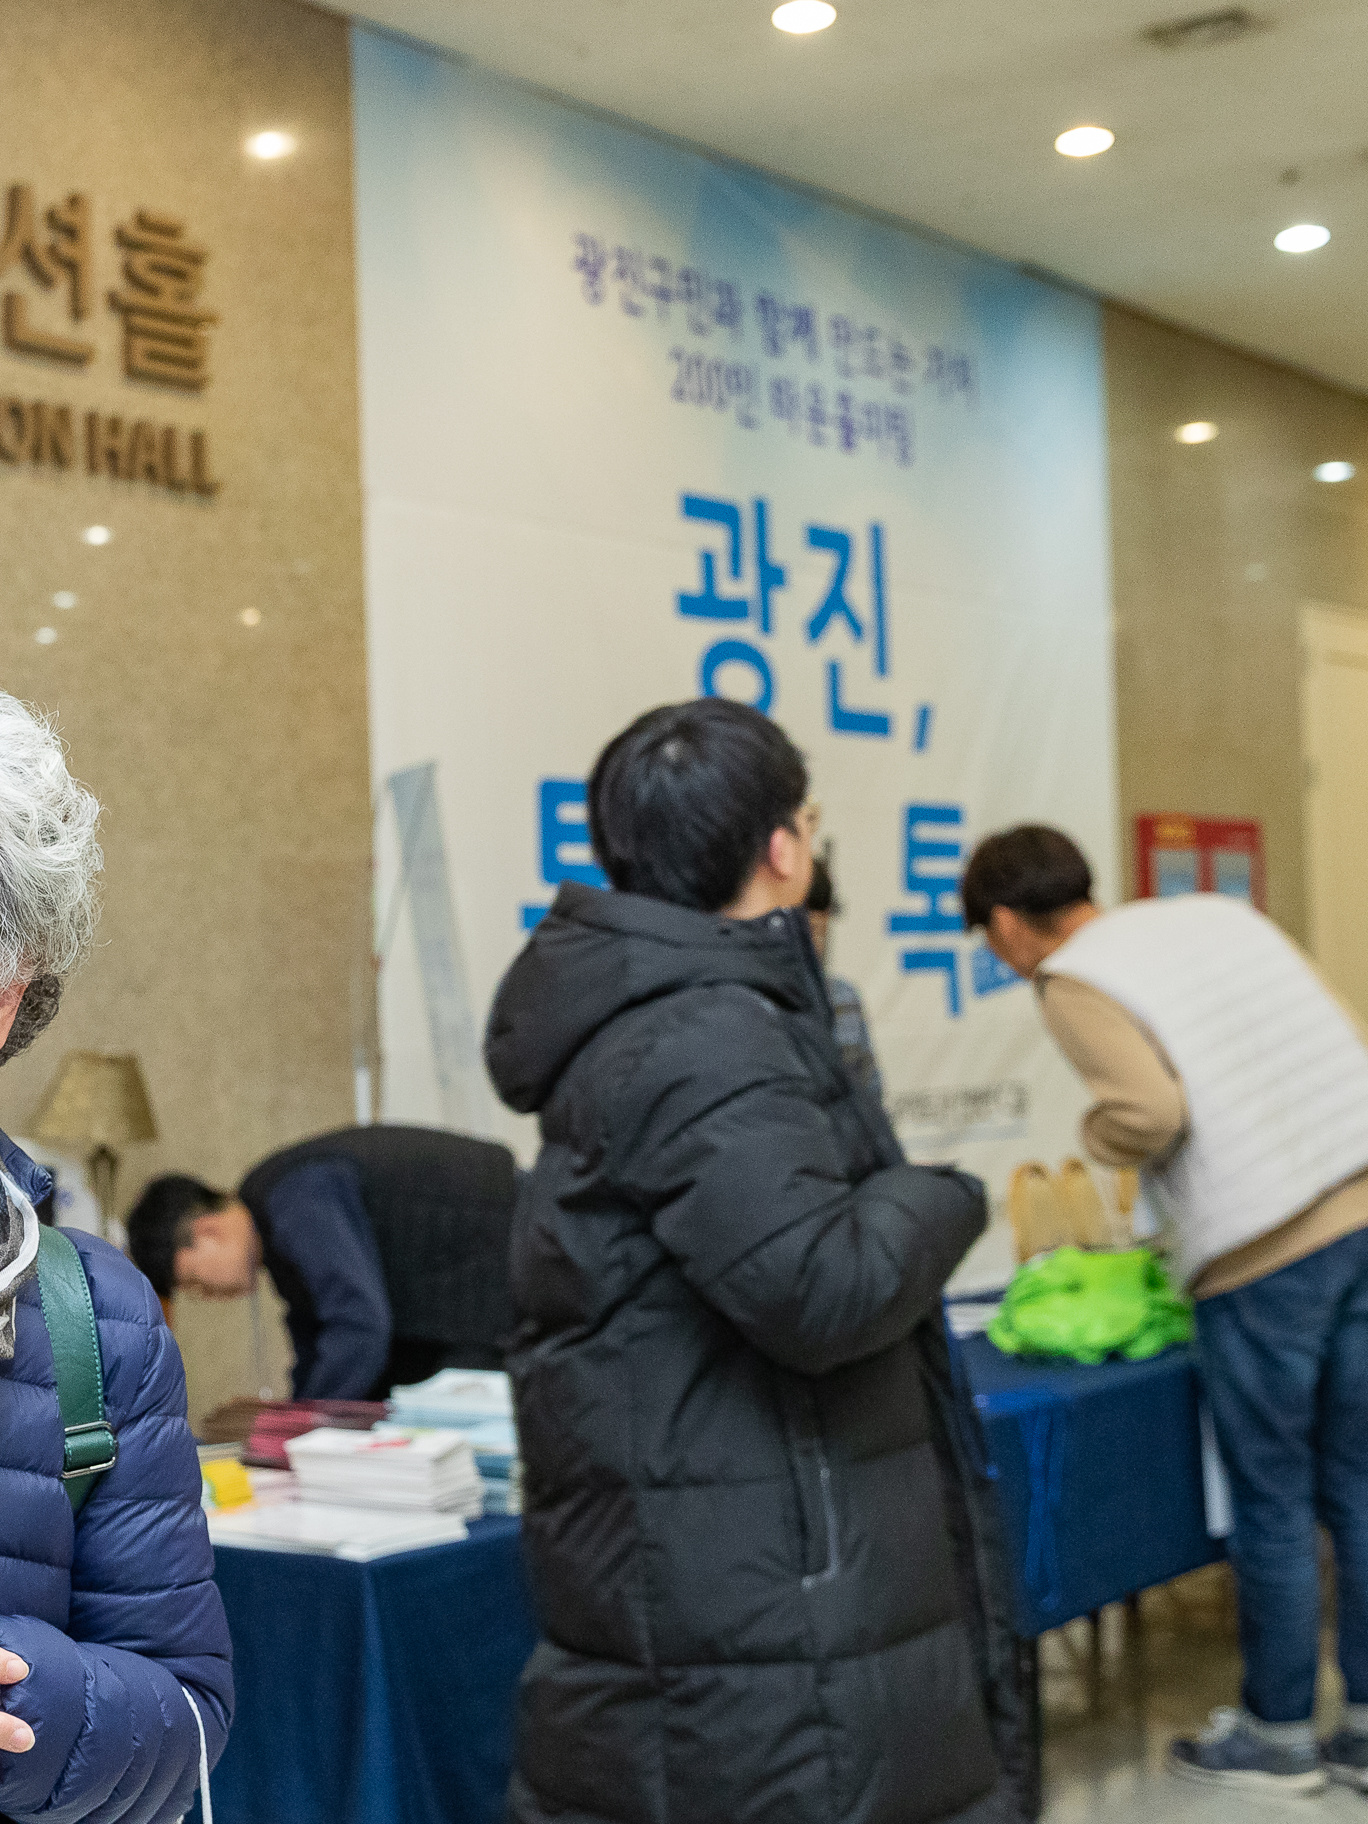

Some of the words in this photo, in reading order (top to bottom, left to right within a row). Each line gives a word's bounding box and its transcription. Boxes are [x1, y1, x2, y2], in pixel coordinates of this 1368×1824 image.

[573, 231, 743, 341] 광진구민과
[755, 290, 819, 365] 함께
[828, 313, 915, 398] 만드는
[669, 345, 759, 430] 200인
[84, 408, 220, 499] HALL
